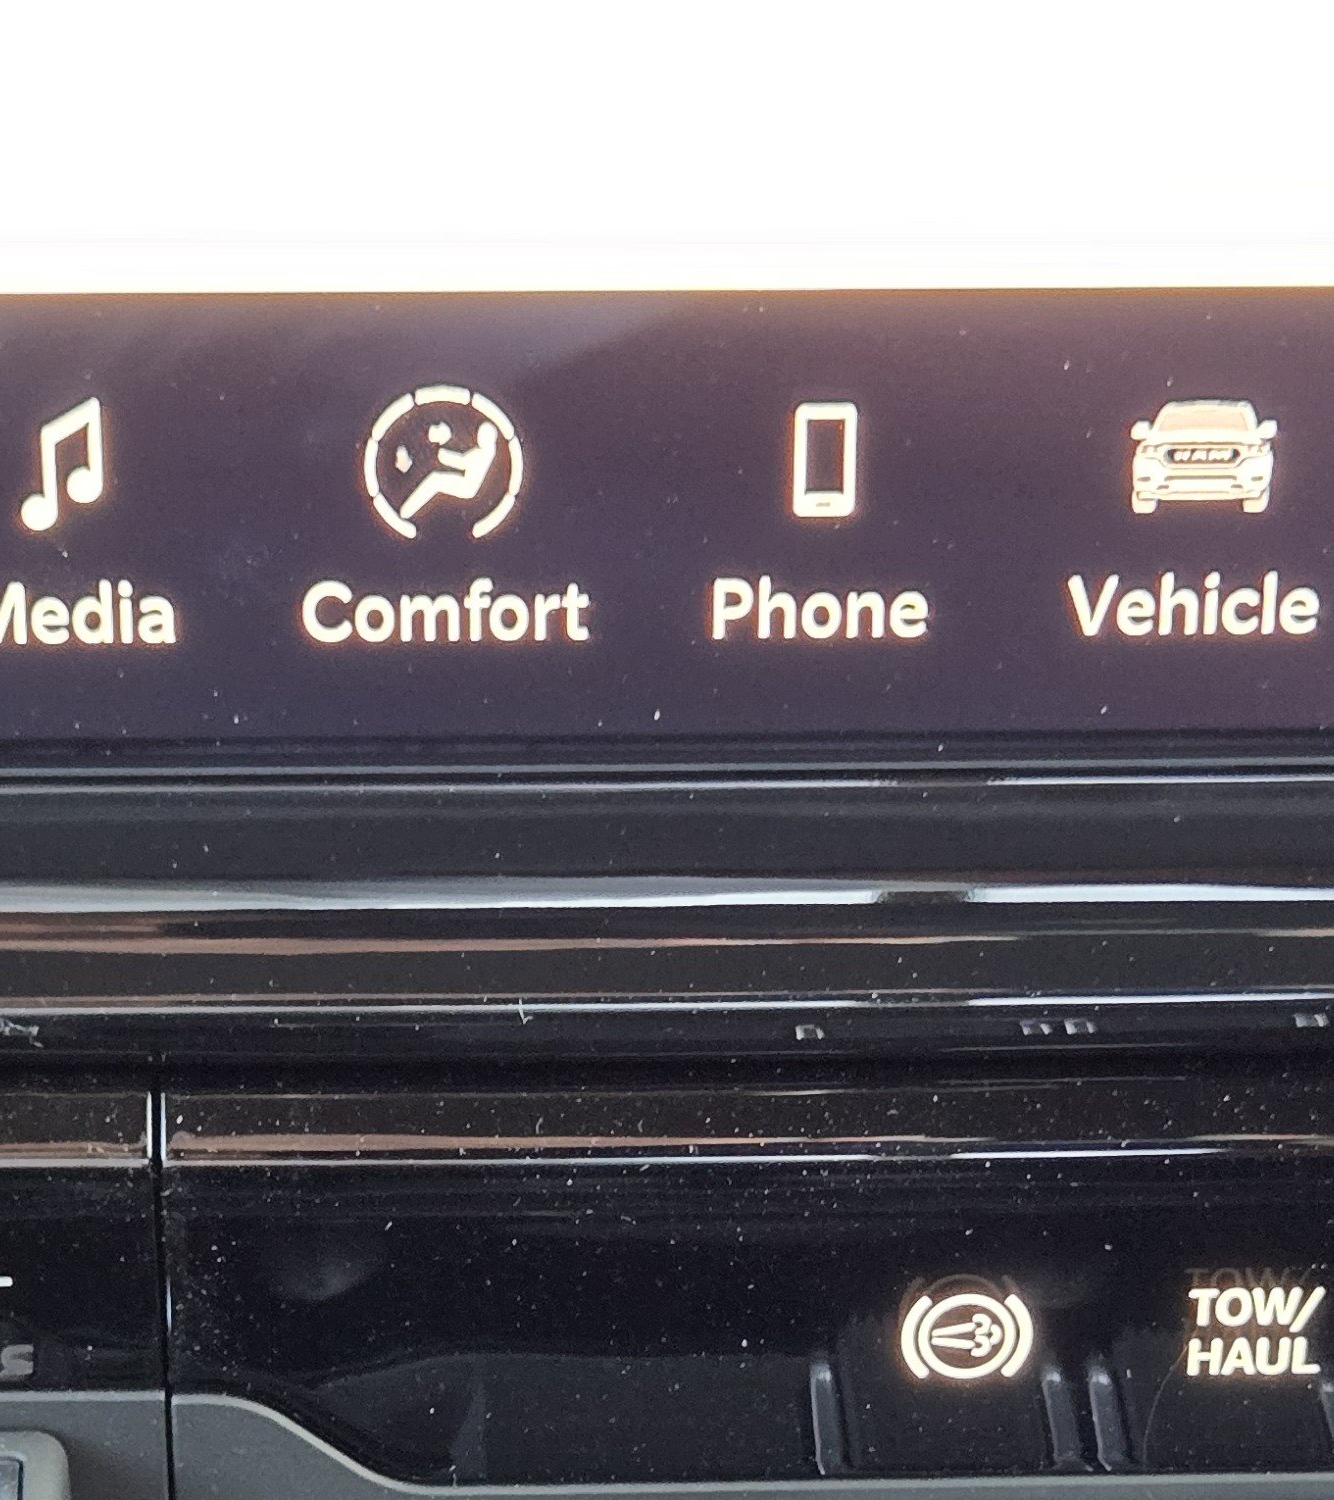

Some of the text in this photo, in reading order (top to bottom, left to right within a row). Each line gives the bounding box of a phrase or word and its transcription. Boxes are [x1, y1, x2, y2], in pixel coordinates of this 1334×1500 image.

[301, 577, 591, 643] Comfort
[710, 575, 929, 640] Phone
[1067, 570, 1320, 637] Vehicle
[1187, 1286, 1326, 1333] TOW/
[1186, 1336, 1321, 1377] HAUL
